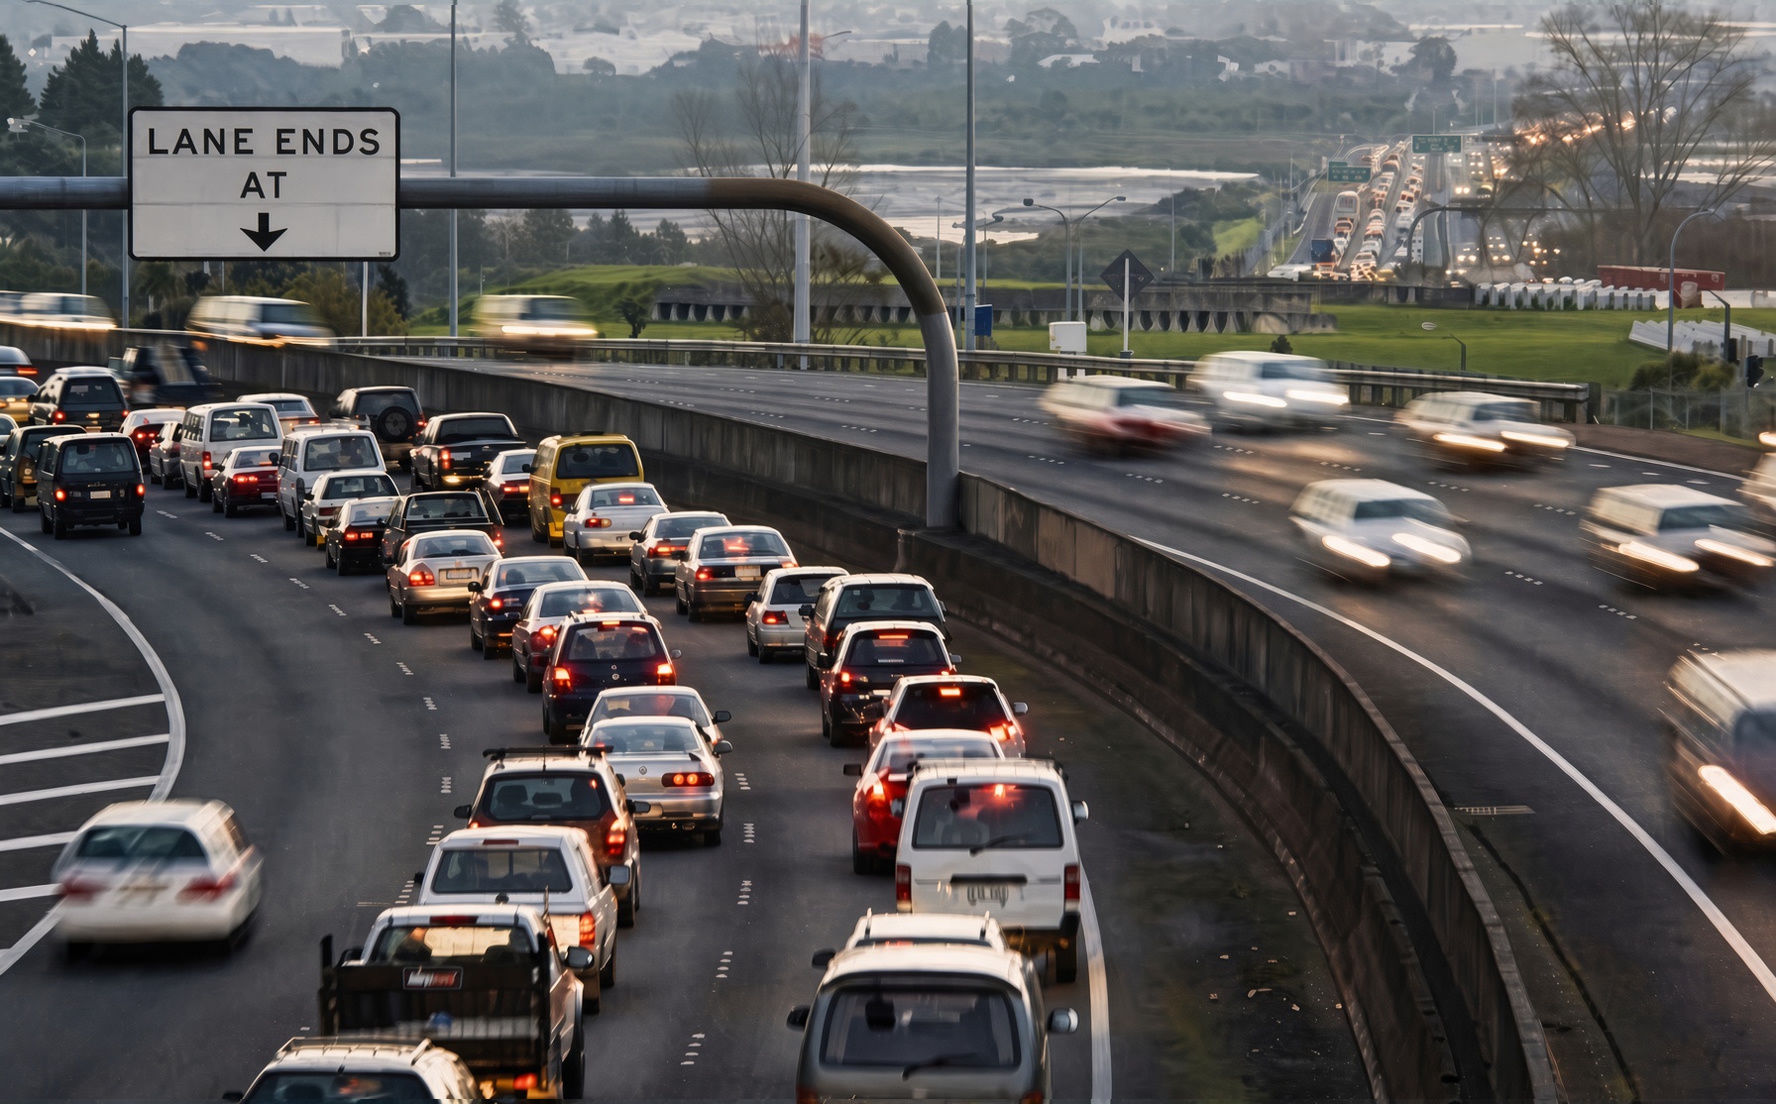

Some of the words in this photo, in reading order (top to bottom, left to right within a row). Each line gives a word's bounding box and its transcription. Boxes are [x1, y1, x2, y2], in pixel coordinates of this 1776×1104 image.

[148, 128, 254, 155] LANE
[276, 128, 380, 155] ENDS
[240, 171, 288, 199] AT
